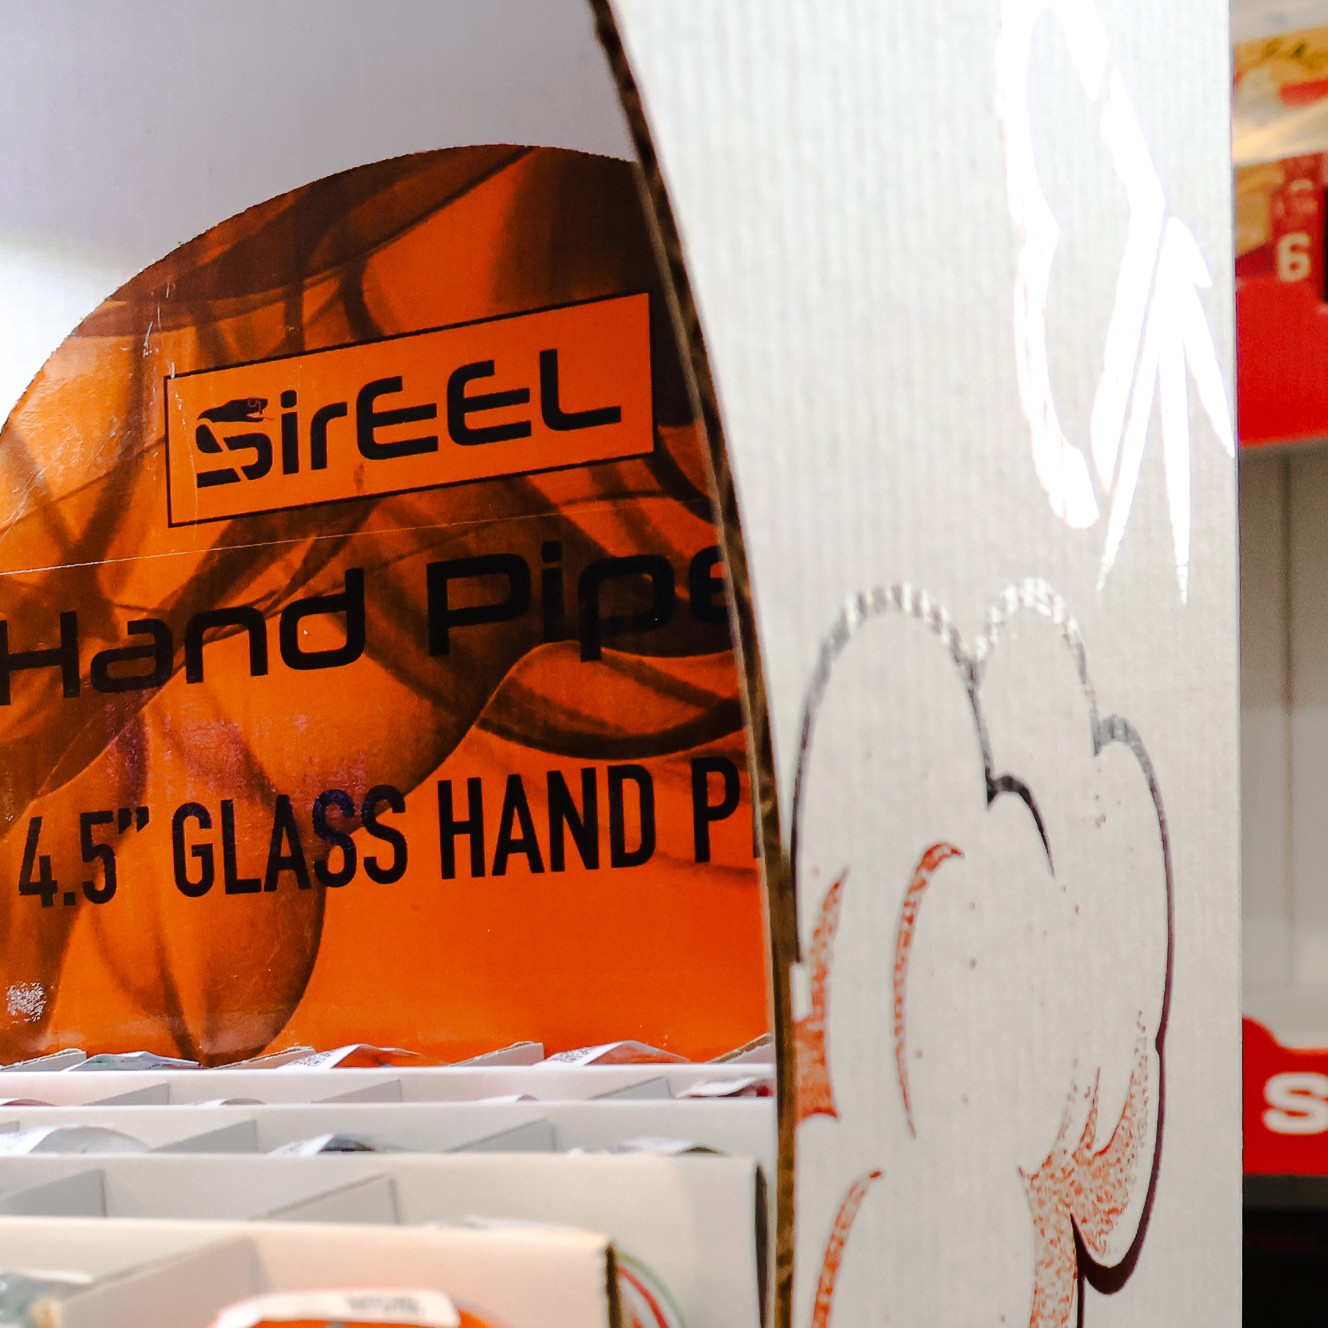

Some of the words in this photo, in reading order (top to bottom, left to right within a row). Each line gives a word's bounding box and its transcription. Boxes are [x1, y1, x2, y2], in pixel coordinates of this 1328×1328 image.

[1276, 232, 1312, 282] 6
[170, 784, 409, 898] GLASS
[440, 763, 658, 880] HAND
